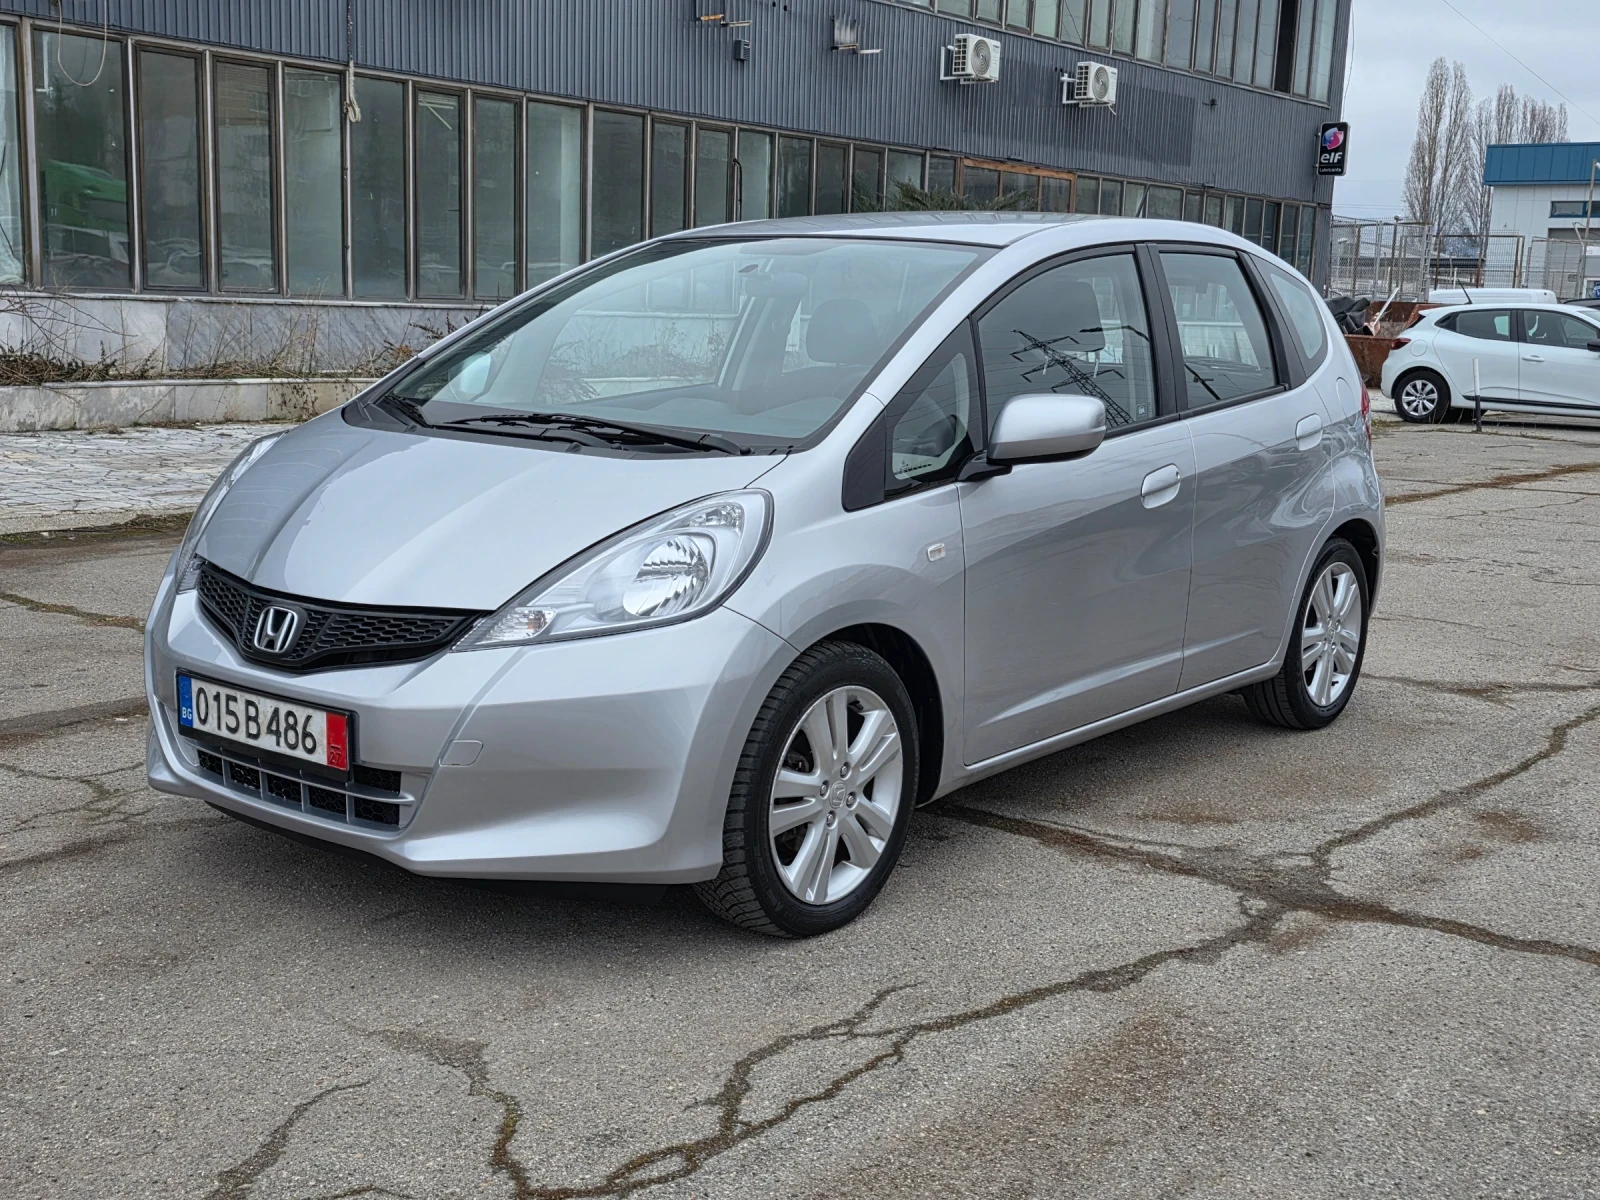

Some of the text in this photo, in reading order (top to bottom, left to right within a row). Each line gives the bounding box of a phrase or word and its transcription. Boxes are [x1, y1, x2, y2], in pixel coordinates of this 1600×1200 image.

[1320, 152, 1343, 163] elf
[181, 706, 192, 720] BG
[195, 686, 317, 755] 015B486
